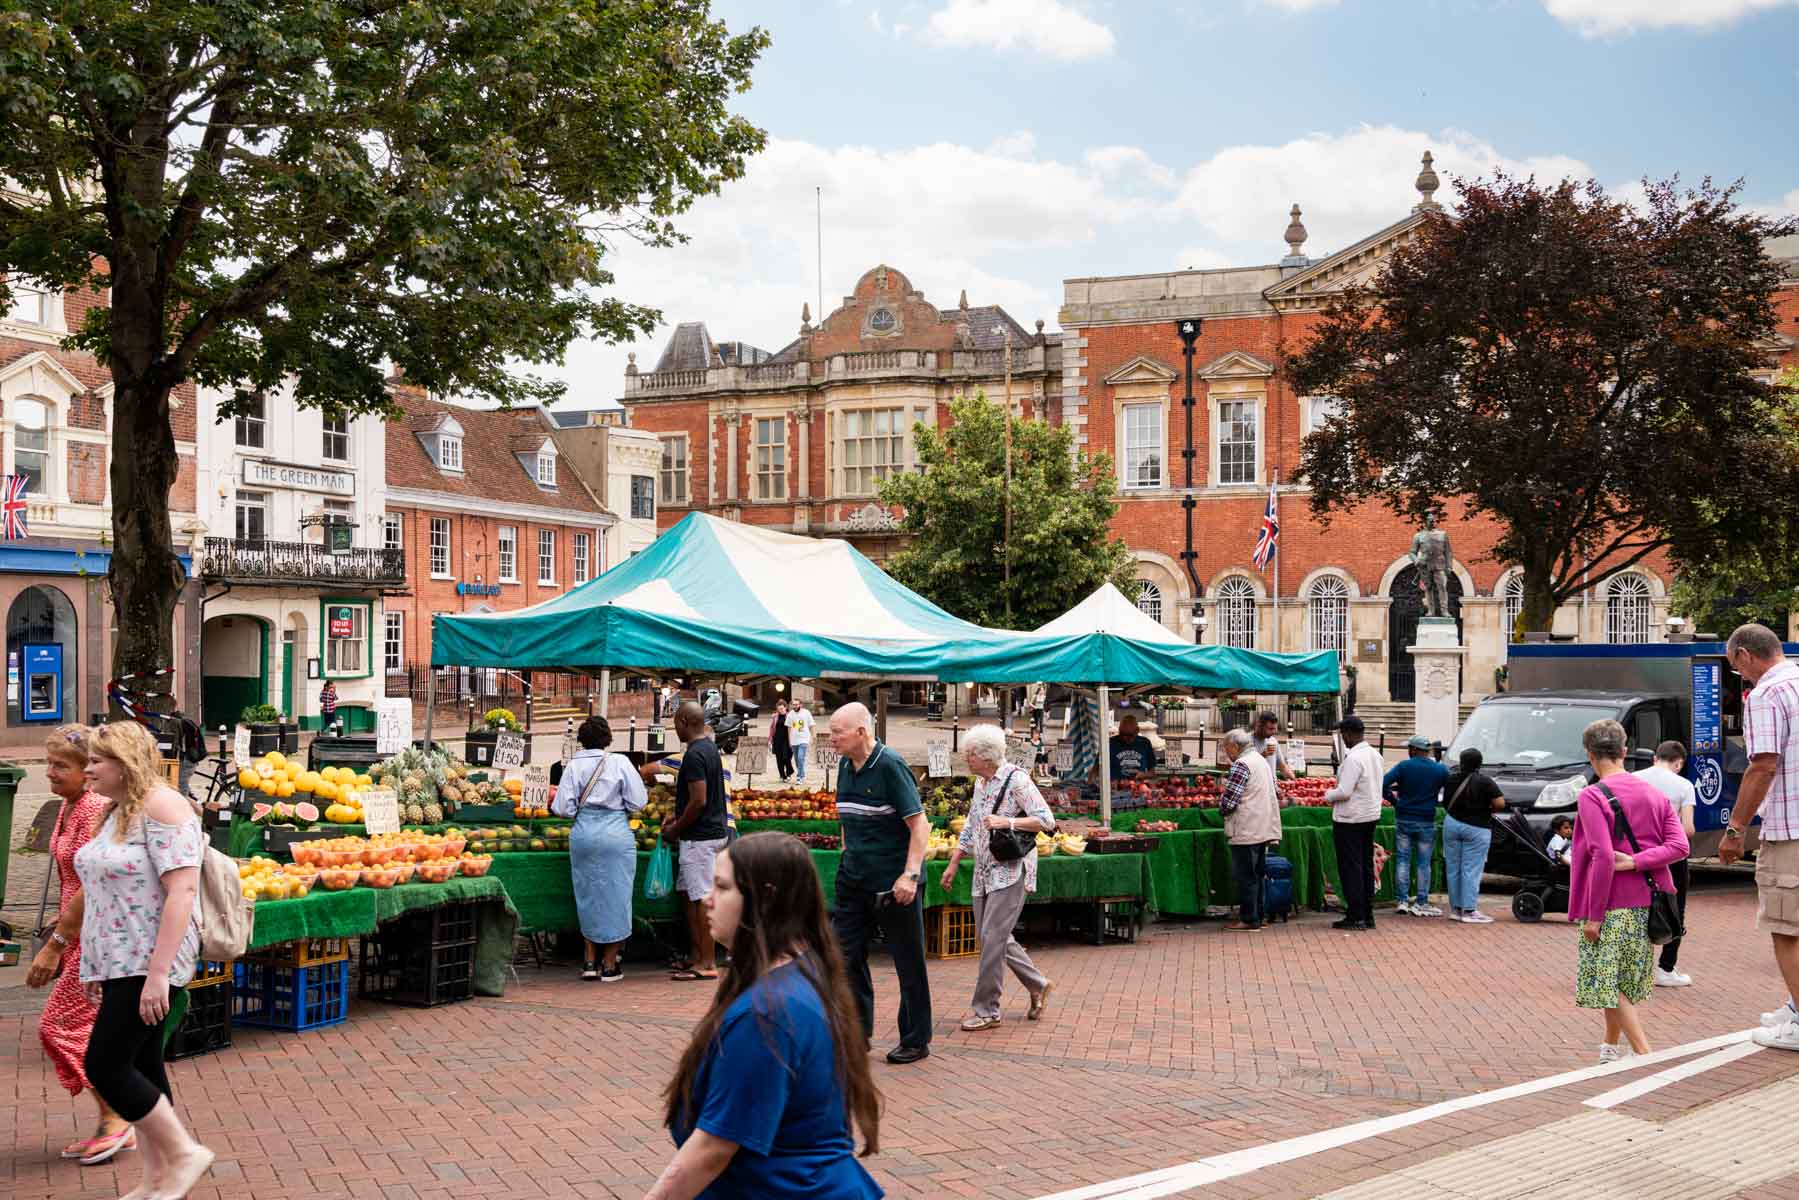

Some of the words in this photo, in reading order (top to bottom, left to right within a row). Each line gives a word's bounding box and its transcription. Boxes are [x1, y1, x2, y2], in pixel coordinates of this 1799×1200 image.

[255, 465, 277, 481] THE
[280, 468, 318, 486] GREEN
[321, 474, 345, 489] MAN
